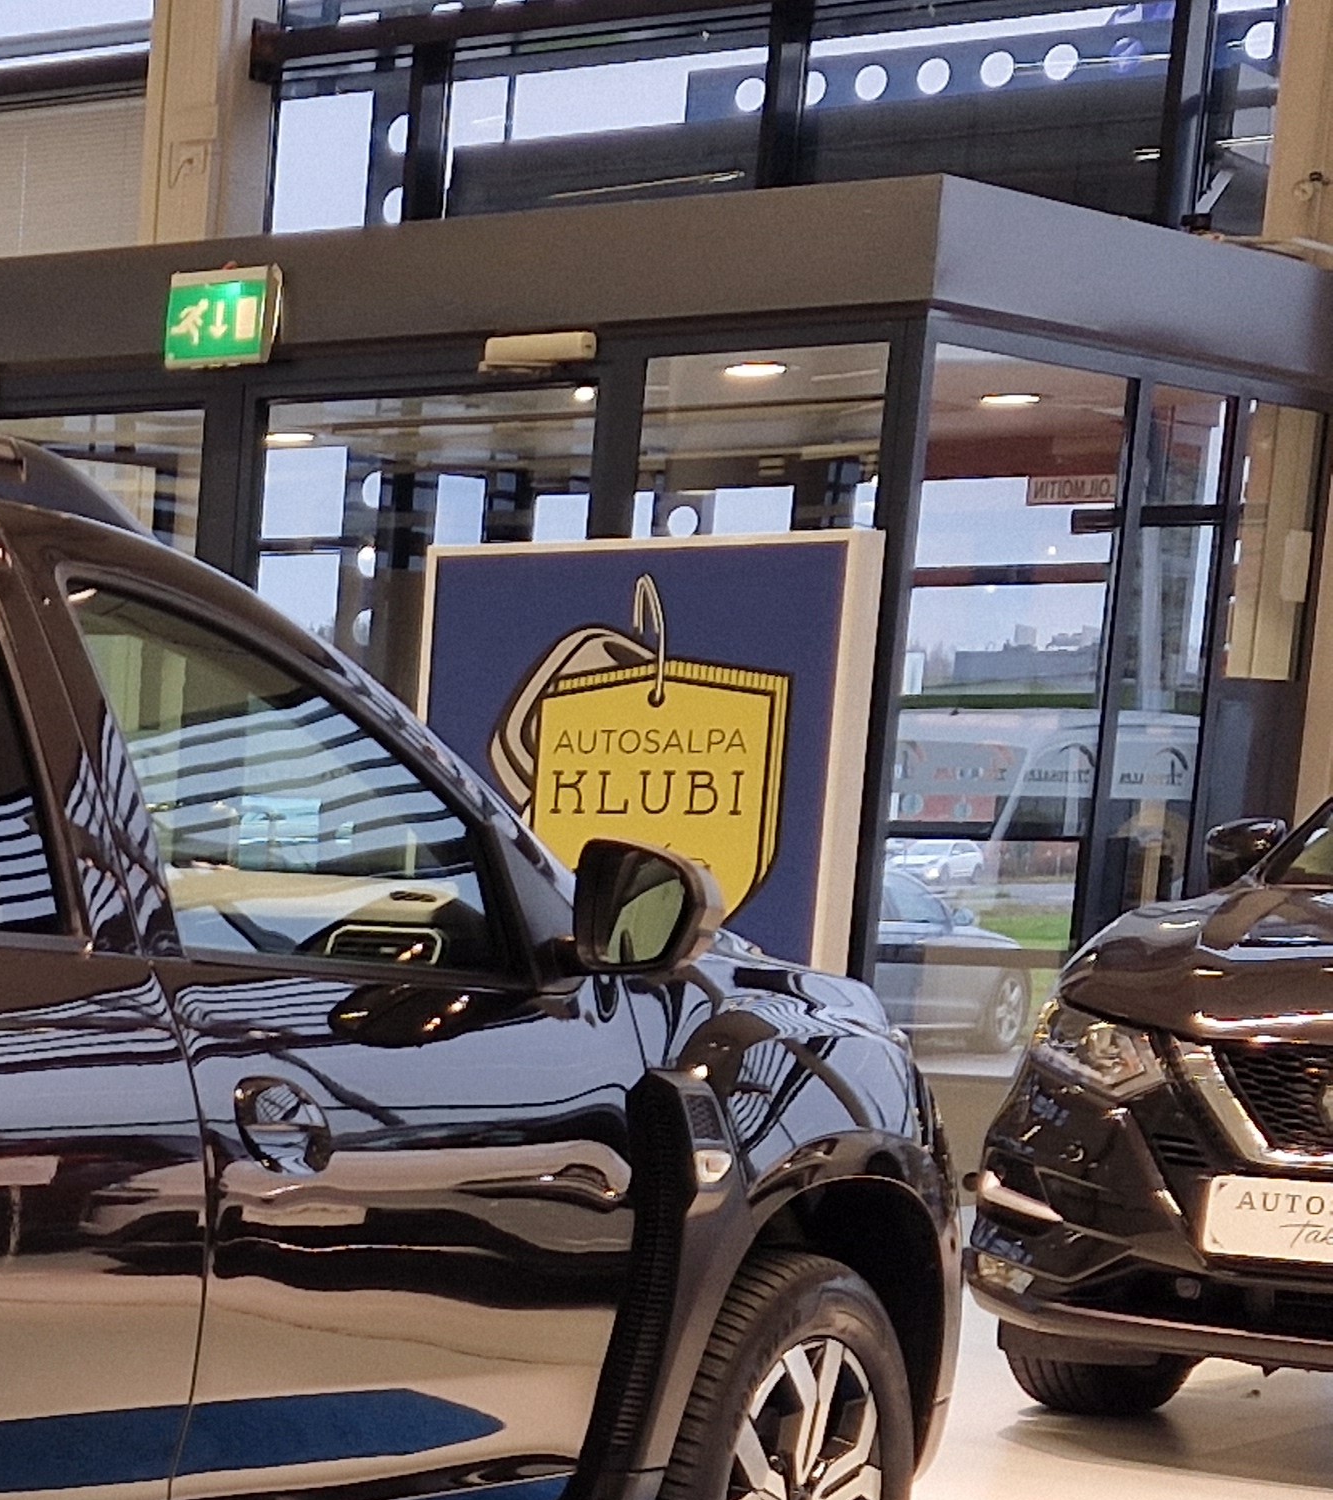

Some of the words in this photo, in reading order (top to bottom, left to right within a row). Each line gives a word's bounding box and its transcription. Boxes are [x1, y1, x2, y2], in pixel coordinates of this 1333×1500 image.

[553, 728, 747, 755] AUTOSALPA
[549, 769, 745, 815] KLUBI
[1235, 1190, 1333, 1215] AUTO
